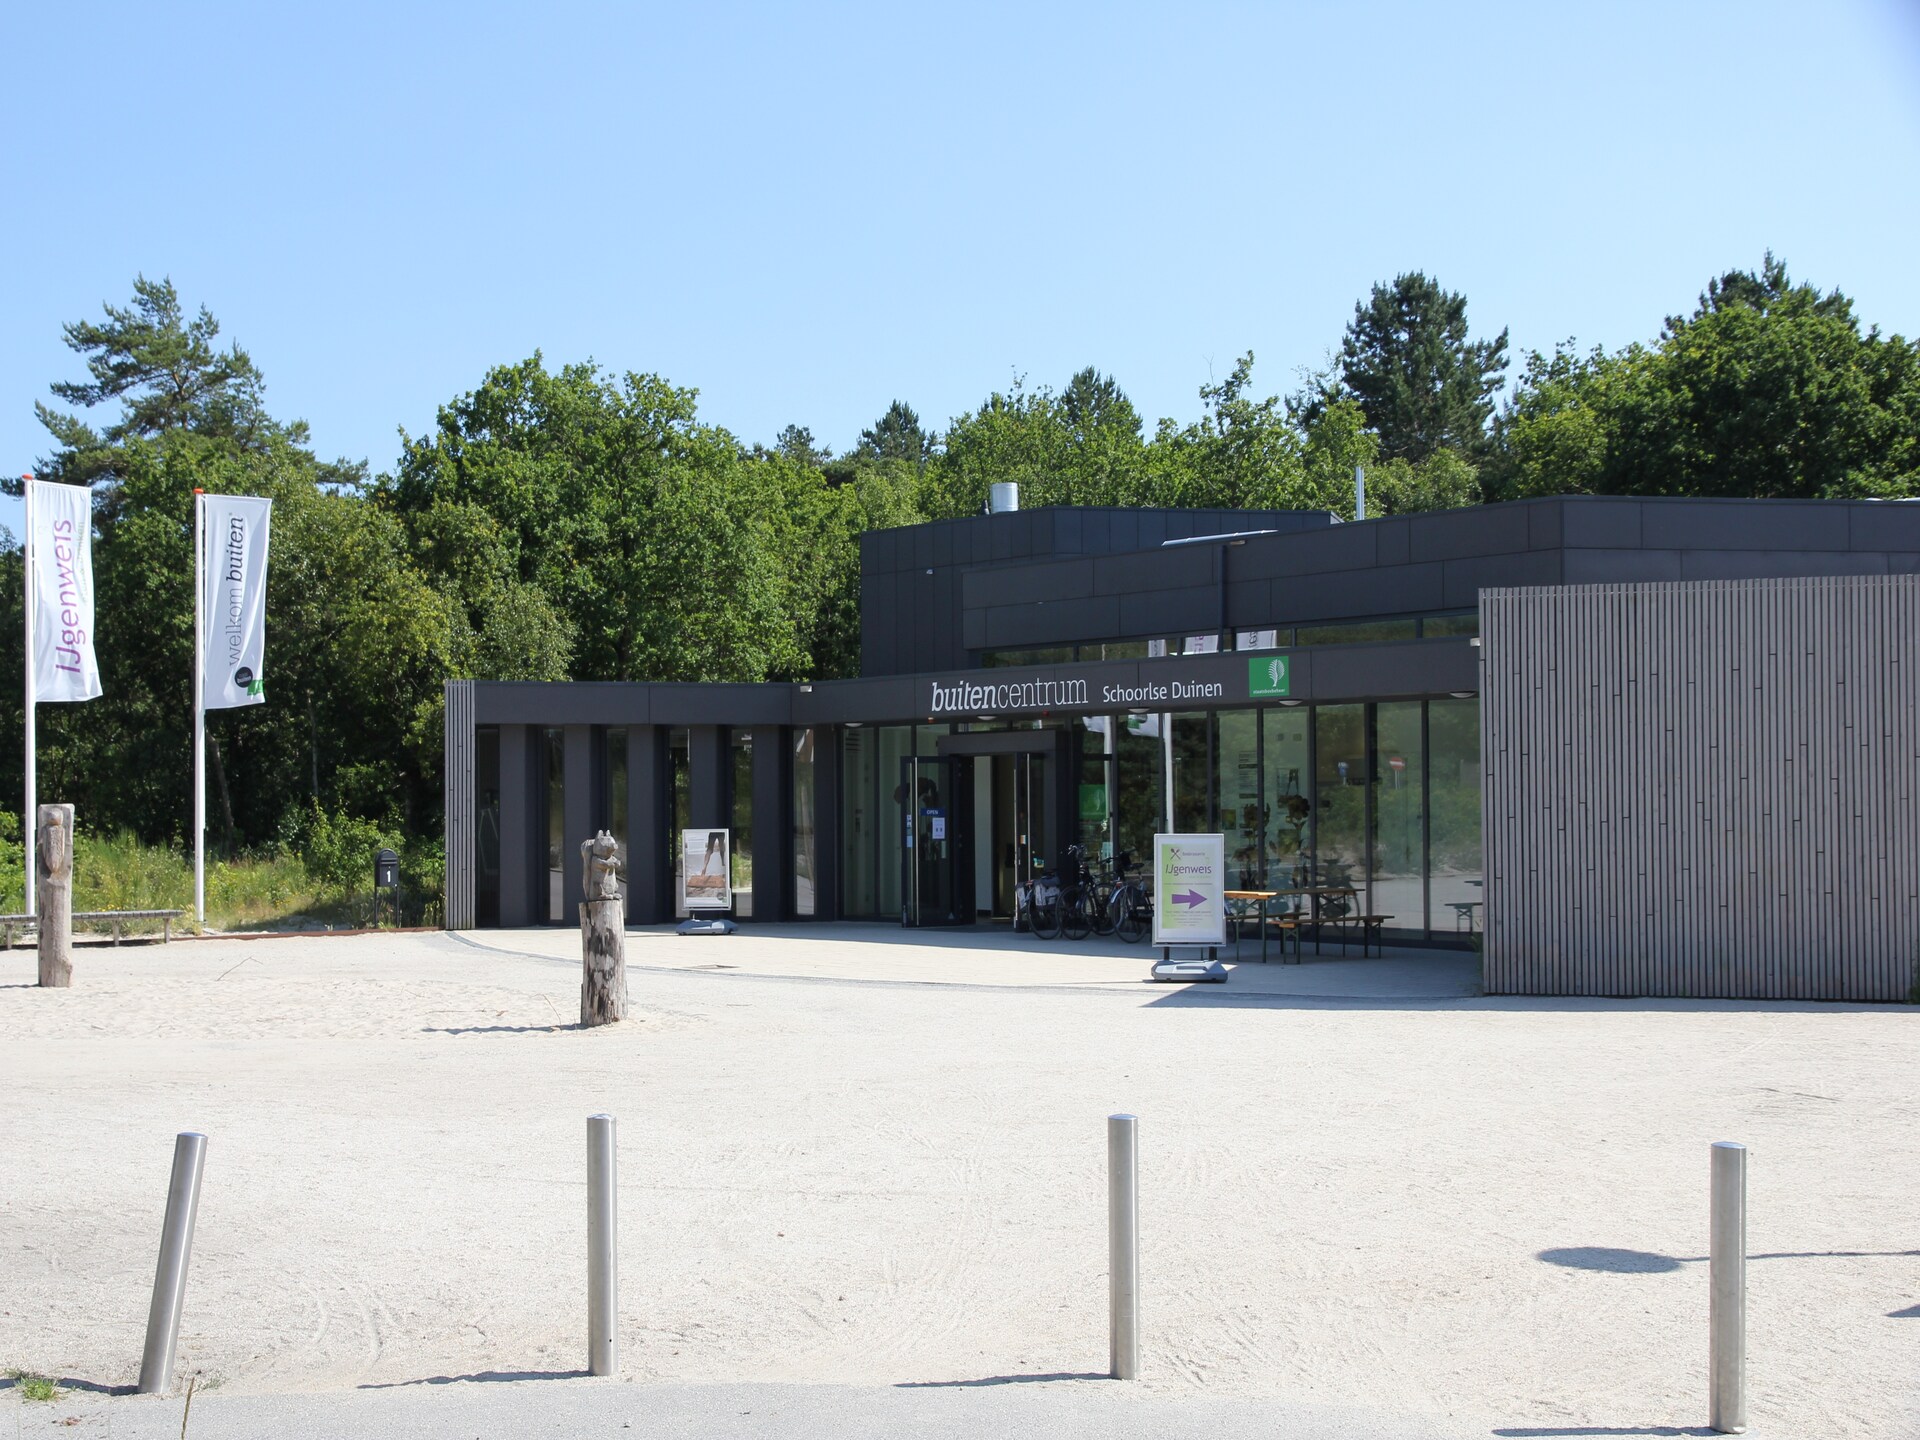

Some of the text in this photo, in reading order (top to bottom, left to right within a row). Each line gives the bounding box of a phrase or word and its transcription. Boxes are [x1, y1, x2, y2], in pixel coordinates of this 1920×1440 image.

[54, 519, 86, 673] IJgenweis
[226, 517, 244, 667] welkom buiten
[931, 677, 1089, 712] buitencentrum
[1103, 680, 1222, 703] Schoorlse Duinen
[386, 870, 391, 883] 1
[1165, 864, 1212, 876] IJgenweis
